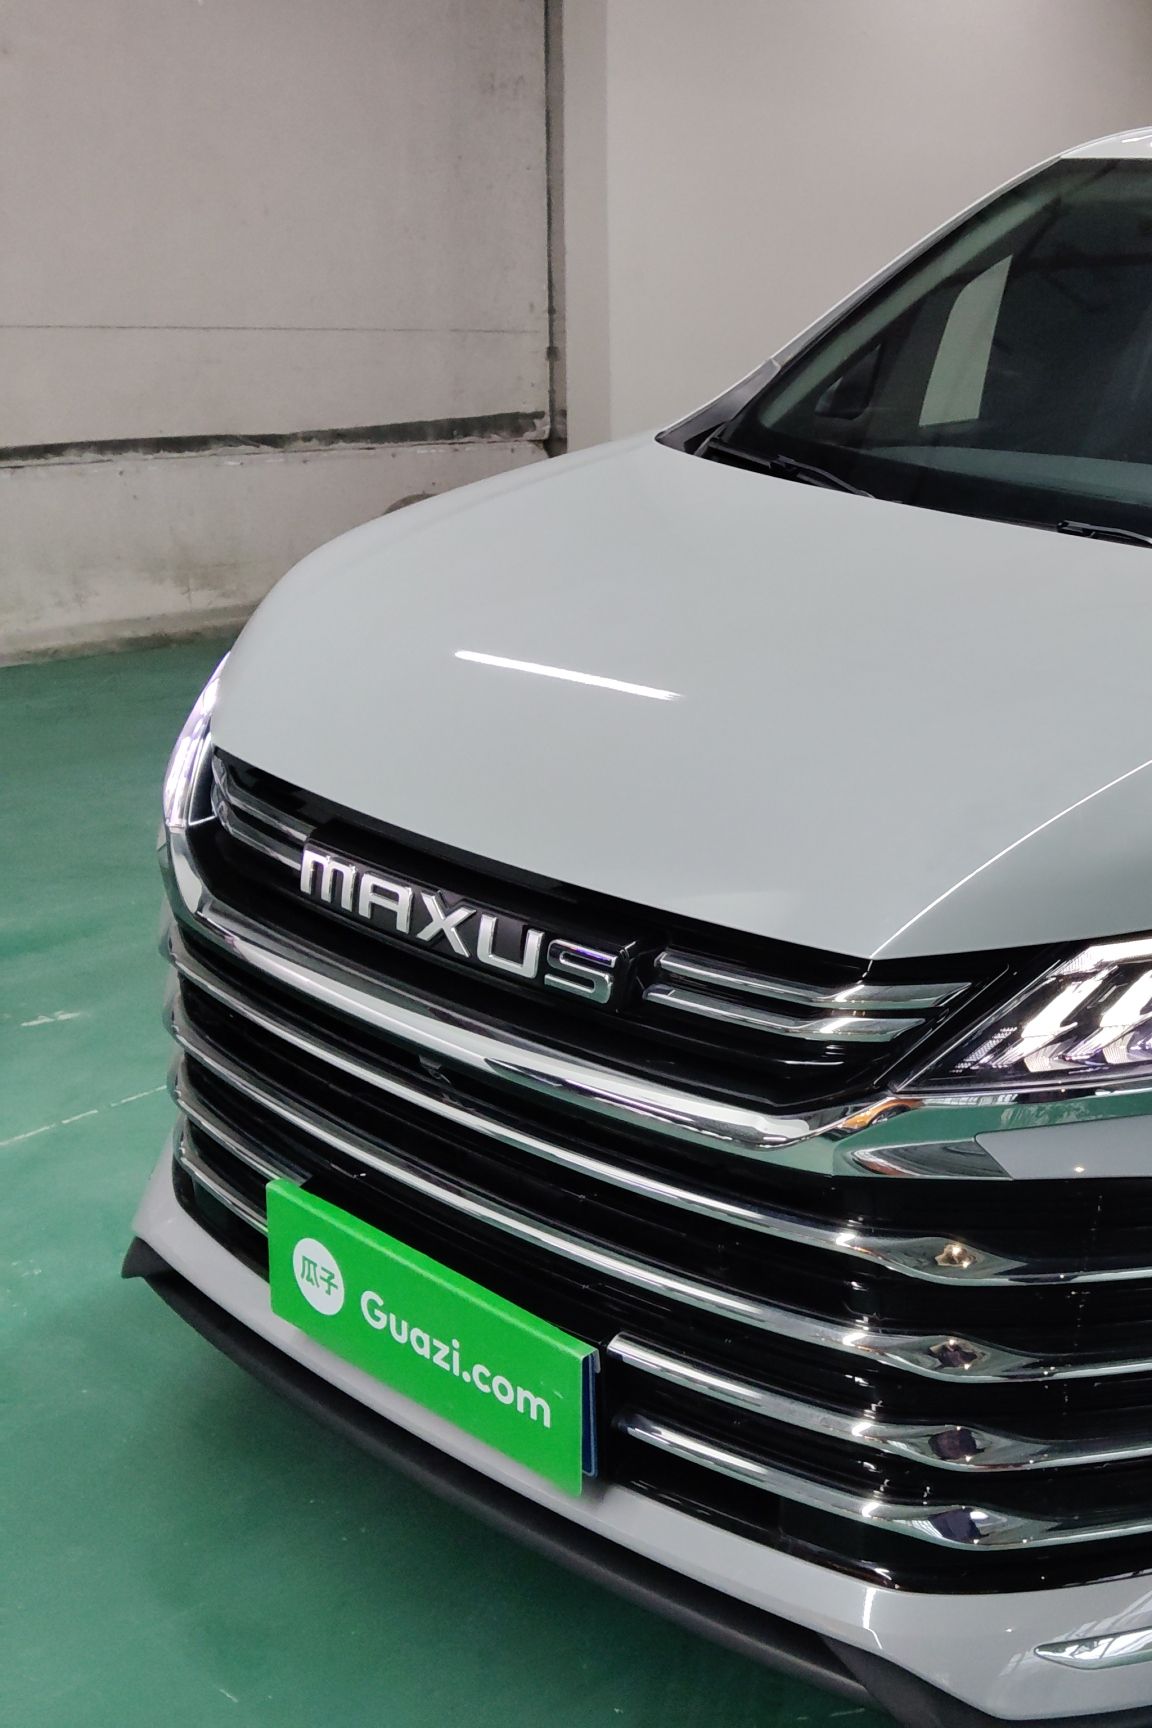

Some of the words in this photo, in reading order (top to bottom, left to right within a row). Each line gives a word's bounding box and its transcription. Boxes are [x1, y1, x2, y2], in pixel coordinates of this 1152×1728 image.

[301, 848, 618, 1004] MAXUS
[299, 1255, 339, 1296] 瓜子
[360, 1290, 551, 1428] Guazi.com
